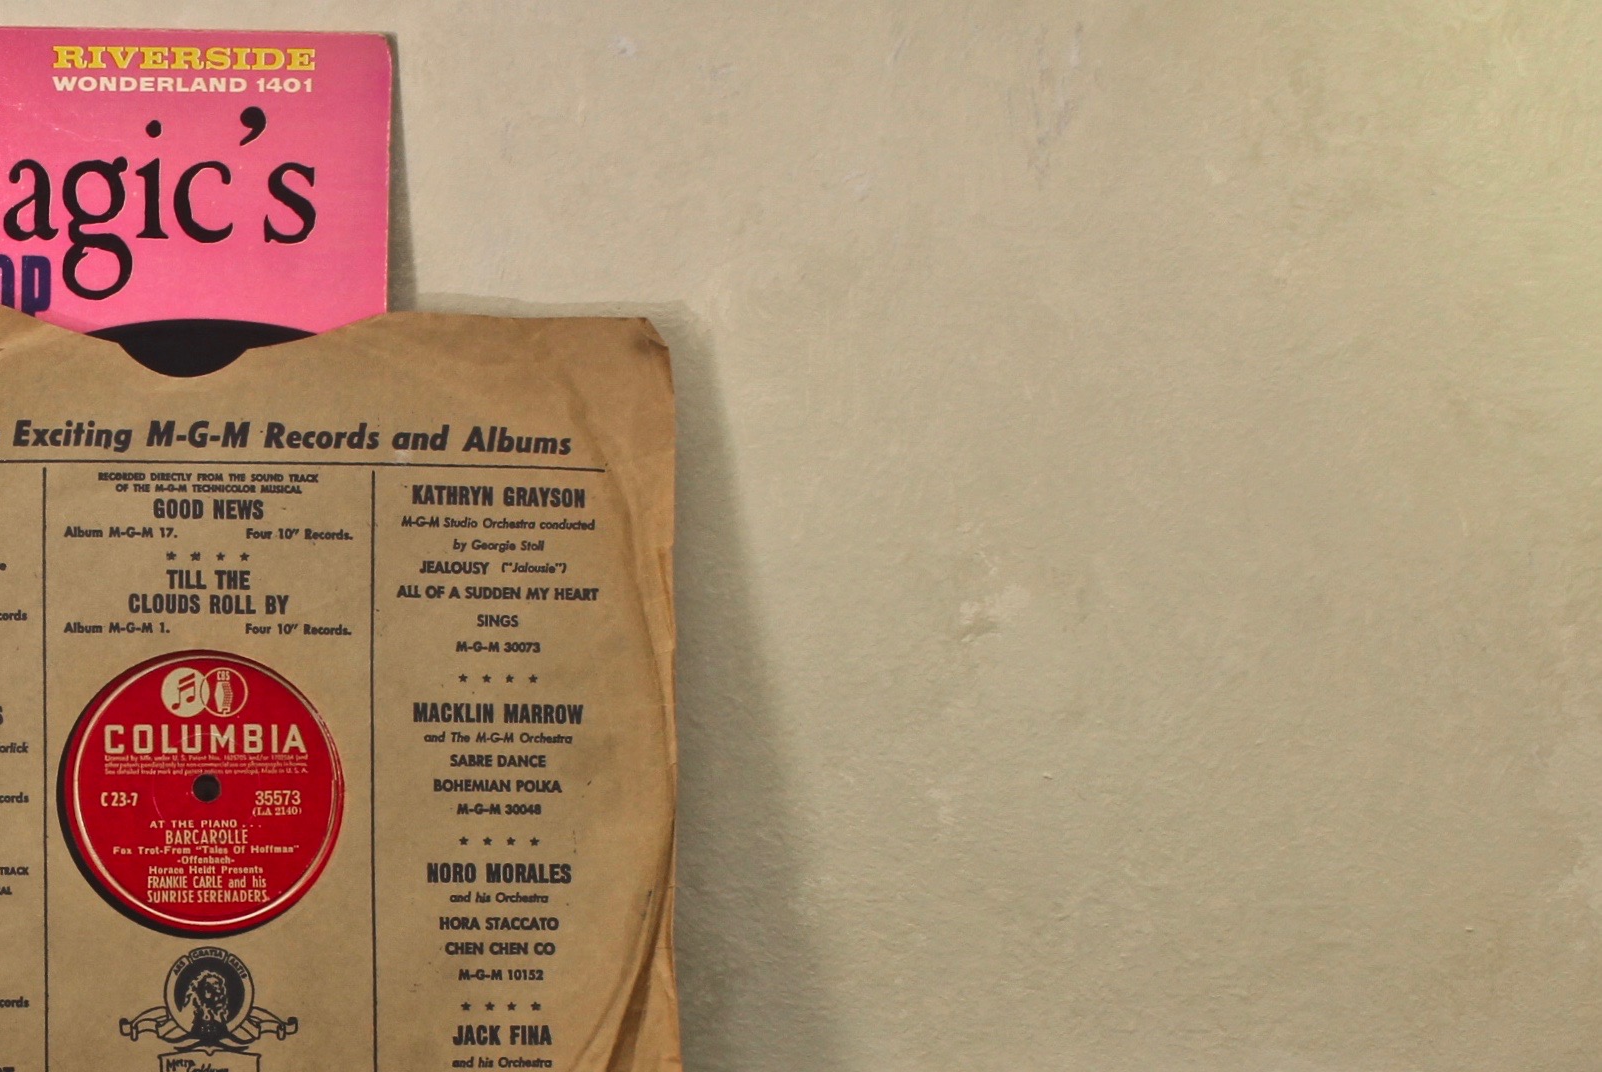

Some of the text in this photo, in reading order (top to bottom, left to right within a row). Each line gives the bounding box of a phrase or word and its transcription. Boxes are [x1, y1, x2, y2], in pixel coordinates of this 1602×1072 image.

[53, 45, 316, 71] RIVERSIDE
[52, 76, 312, 93] WONDERLAND 1401
[12, 419, 133, 454] Exciting
[145, 419, 251, 449] M-G-M
[263, 421, 380, 450] Records
[391, 424, 450, 452] and
[461, 425, 572, 456] Albums
[411, 484, 586, 509] KATHRYN GRAYSON
[153, 498, 264, 521] GOOD NEWS
[165, 569, 251, 591] TILL THE
[128, 593, 290, 615] CLOUDS ROLL BY
[412, 701, 584, 725] MACKLIN MARROW
[104, 723, 307, 755] COLUMBIA
[100, 791, 139, 807] C 23-7
[255, 789, 301, 806] 35573
[149, 819, 238, 829] AT THE PIANO
[165, 828, 248, 845] BARCAROLLE
[112, 846, 133, 855] Fox
[232, 845, 246, 855] Of
[147, 875, 267, 889] FRANKIE CARLE and his
[426, 862, 572, 885] NORO MORALES
[147, 889, 194, 904] SUNRISE
[452, 1024, 553, 1046] JACK FINA
